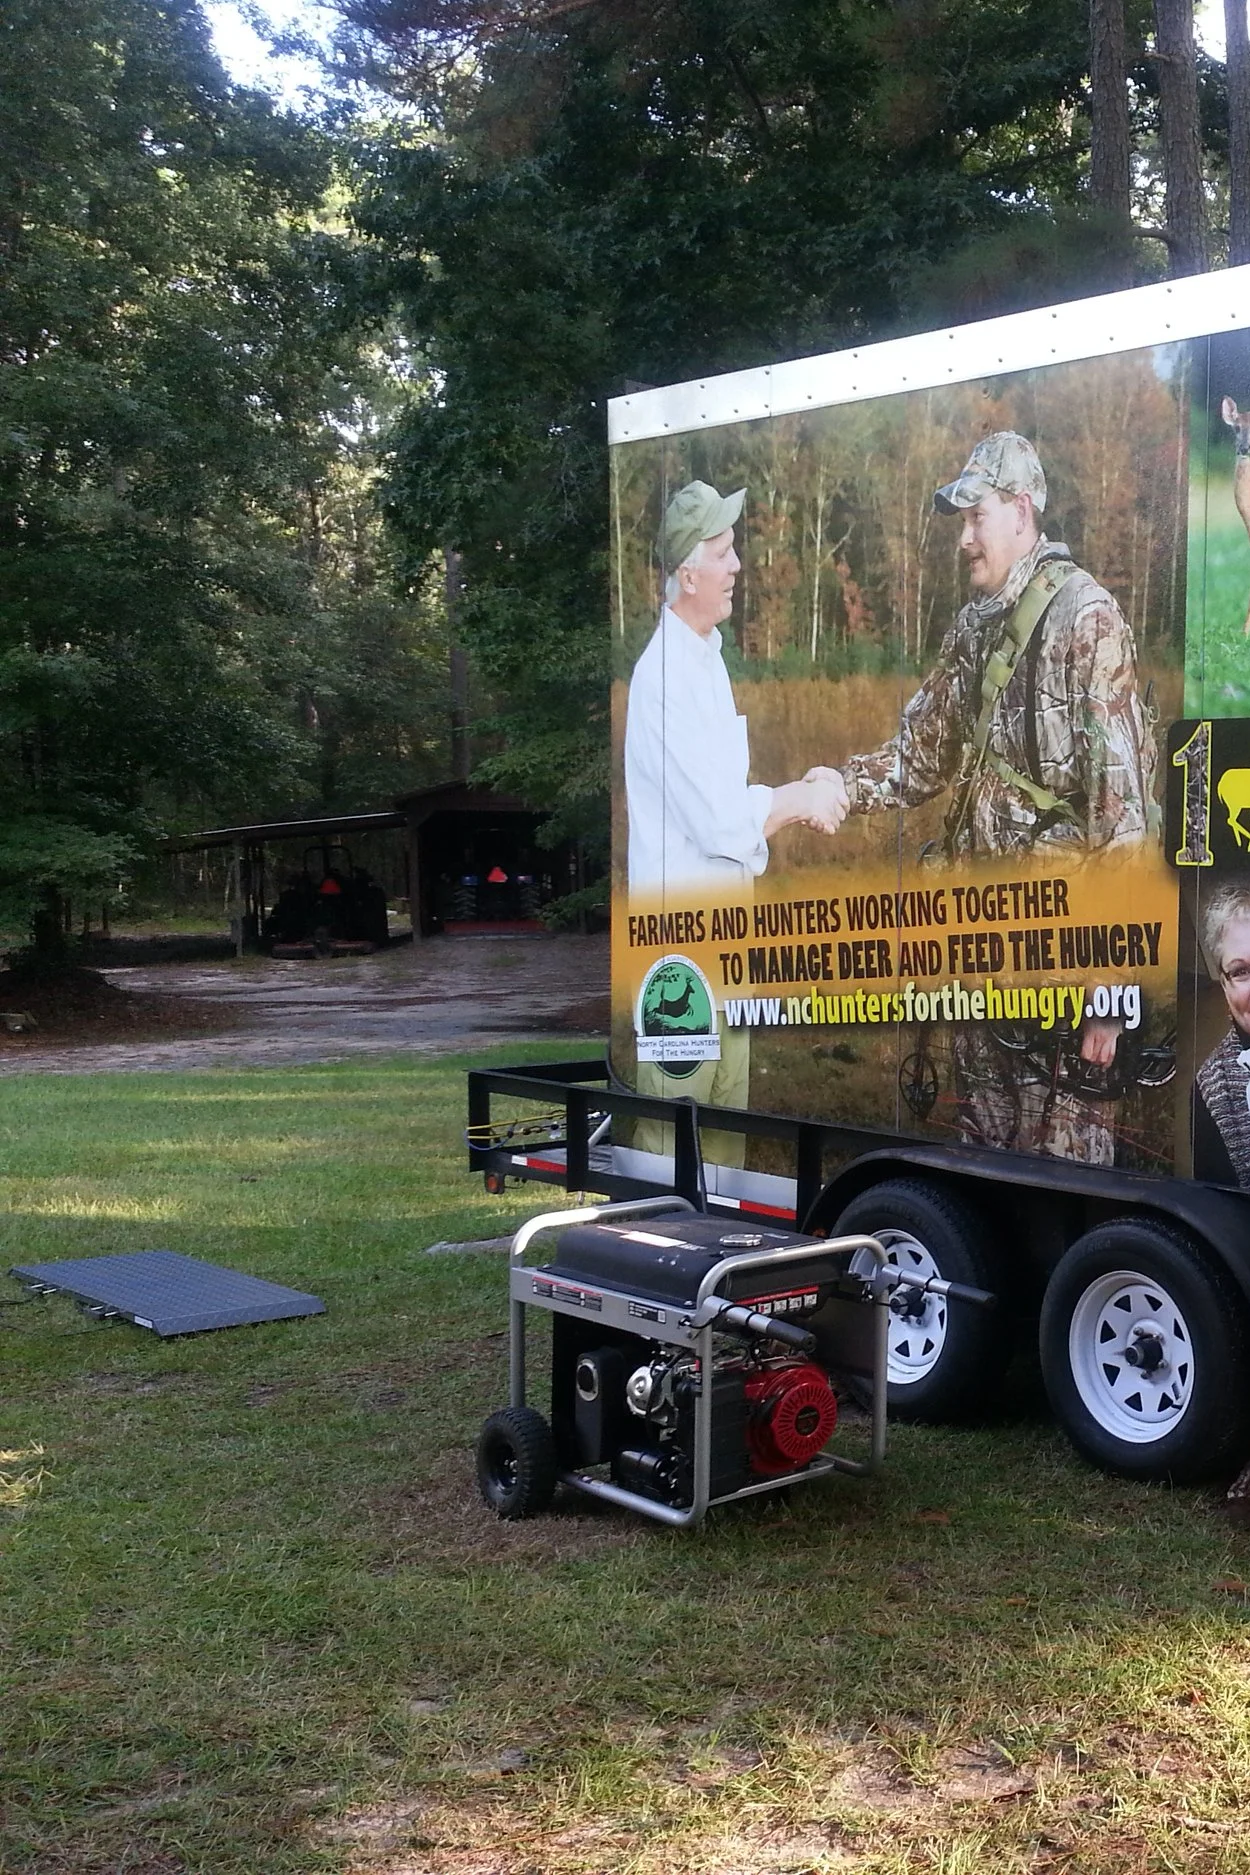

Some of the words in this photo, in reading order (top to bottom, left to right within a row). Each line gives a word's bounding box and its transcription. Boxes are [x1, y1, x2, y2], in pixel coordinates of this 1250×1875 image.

[1173, 721, 1214, 867] 1
[628, 910, 705, 947] FARMERS
[711, 906, 749, 941] AND
[753, 898, 841, 938] HUNTERS
[845, 889, 947, 932] WORKING
[952, 878, 1069, 924] TOGETHER
[720, 952, 743, 986] TO
[747, 942, 833, 985] MANAGE
[838, 938, 893, 980] DEER
[900, 940, 942, 977] AND
[947, 931, 1004, 975] FEED
[1008, 928, 1055, 972] THE
[1059, 922, 1162, 970] HUNGRY
[724, 977, 1141, 1030] www.nchuntersforthehungry.org
